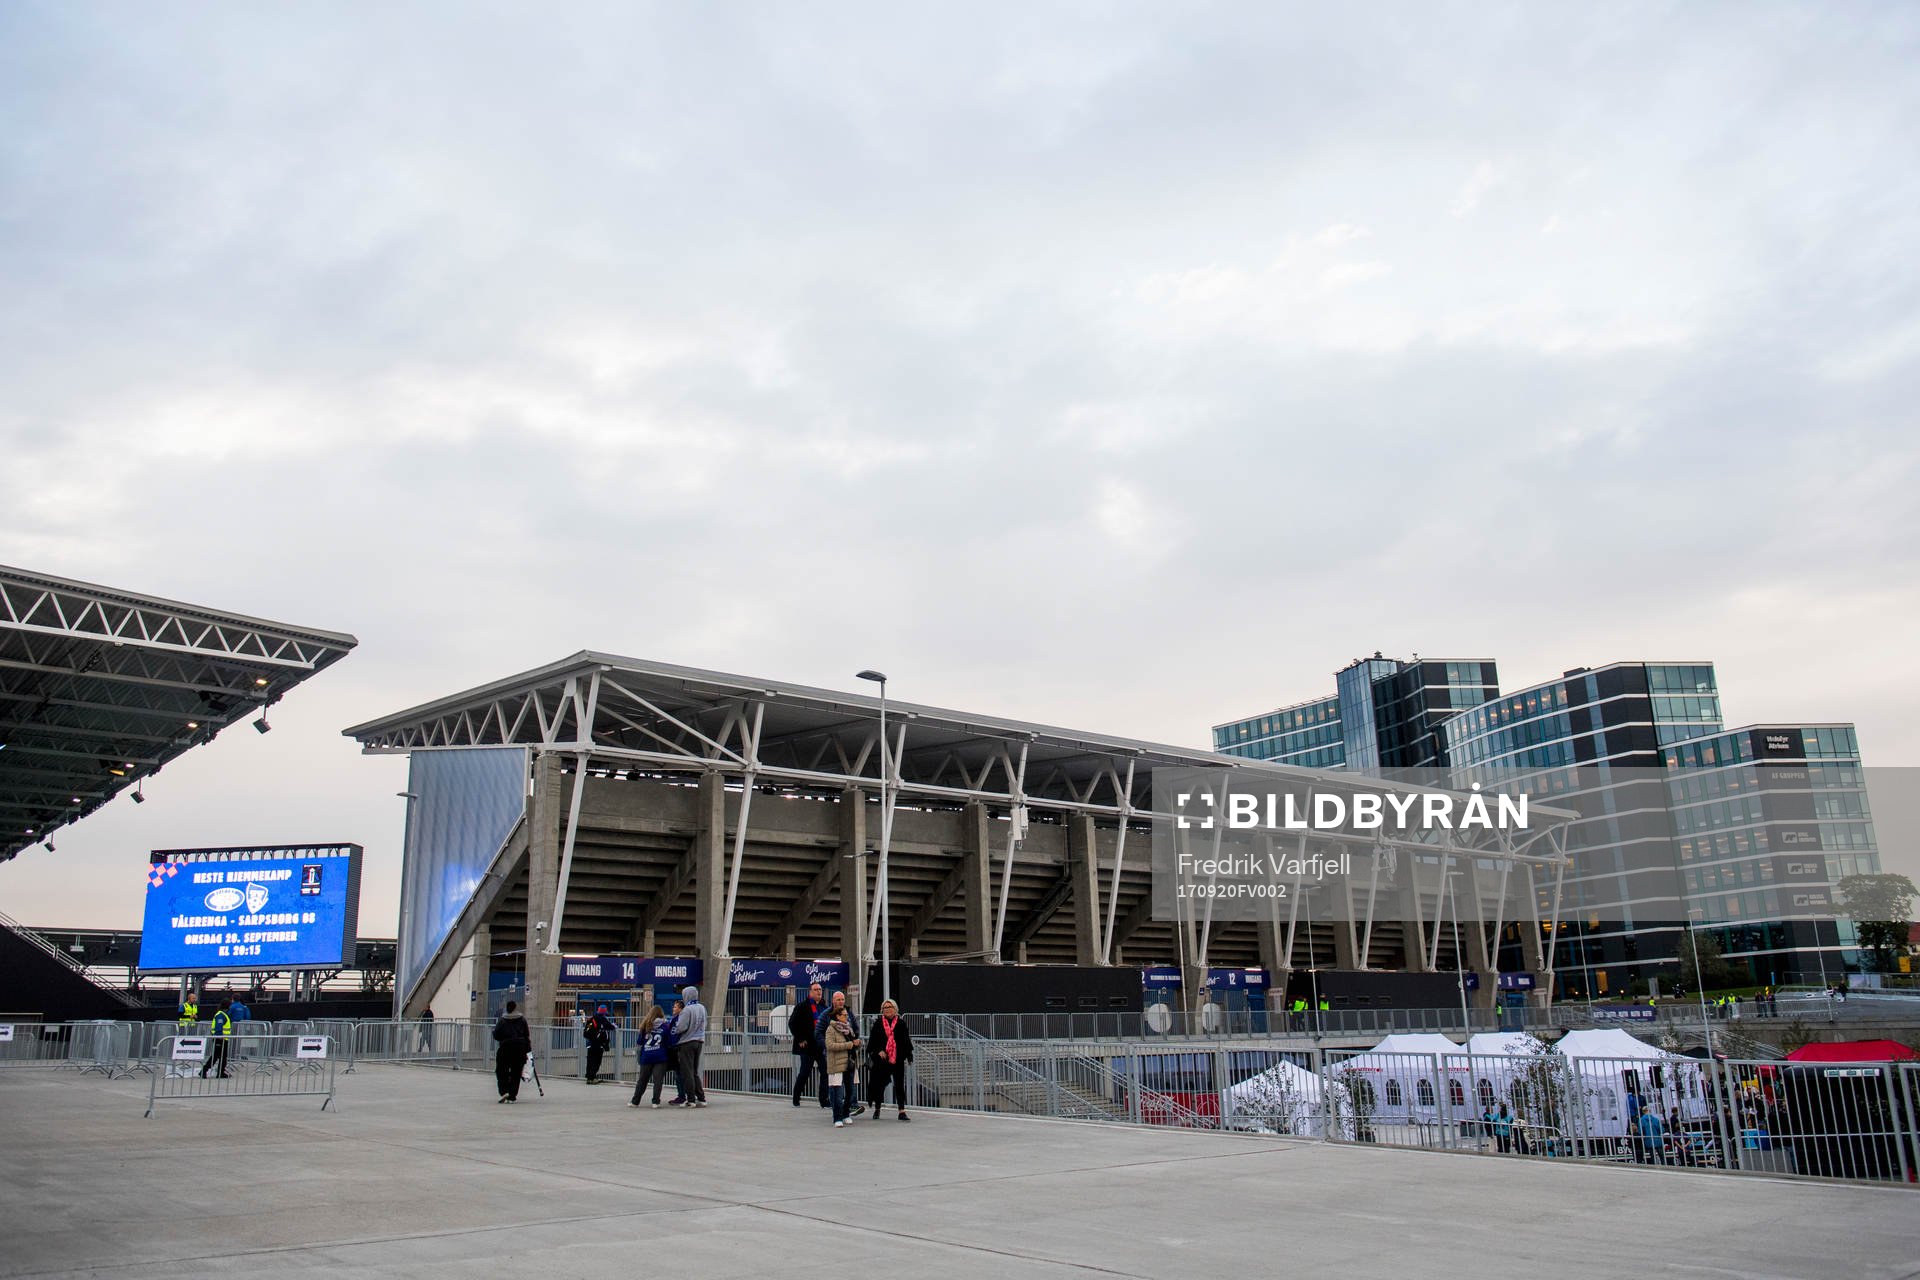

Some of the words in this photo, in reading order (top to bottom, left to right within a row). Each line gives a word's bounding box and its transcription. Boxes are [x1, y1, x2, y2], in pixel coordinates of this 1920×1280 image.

[193, 871, 224, 884] NESTE
[226, 869, 292, 883] HJEMMEKAMP
[171, 914, 227, 928] VÅLERENGA
[238, 913, 299, 926] SARPSBORG
[184, 933, 222, 945] ONSDAG
[244, 931, 298, 943] SEPTEMBER
[218, 945, 230, 956] KL
[232, 945, 261, 956] 20:15
[566, 963, 601, 977] INNGANG
[622, 962, 634, 980] 14
[655, 965, 687, 978] INNGANG
[1228, 972, 1236, 985] 12
[644, 1033, 662, 1048] 22
